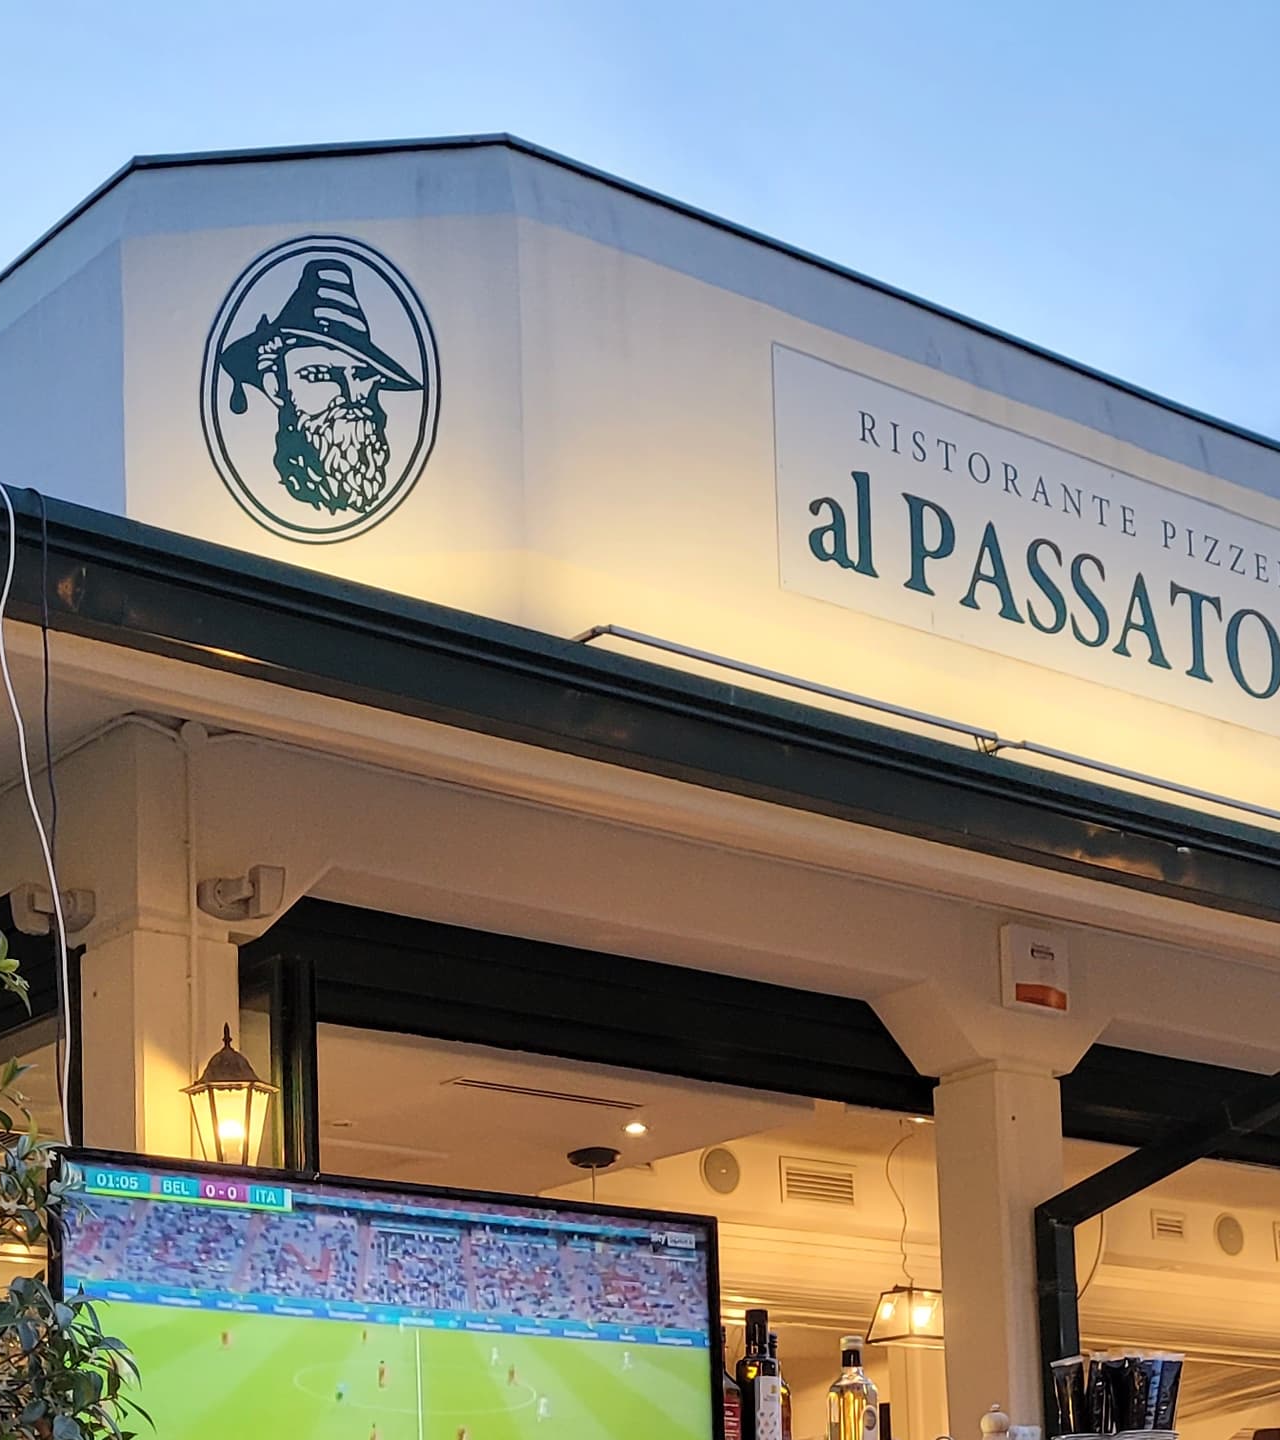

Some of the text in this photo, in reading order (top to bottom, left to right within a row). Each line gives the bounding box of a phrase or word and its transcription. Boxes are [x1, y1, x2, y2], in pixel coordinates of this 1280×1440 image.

[807, 470, 880, 580] al
[858, 409, 1138, 538] RISTORANTE
[96, 1173, 139, 1190] 01:05
[162, 1179, 190, 1196] BEL
[255, 1189, 277, 1205] ITA
